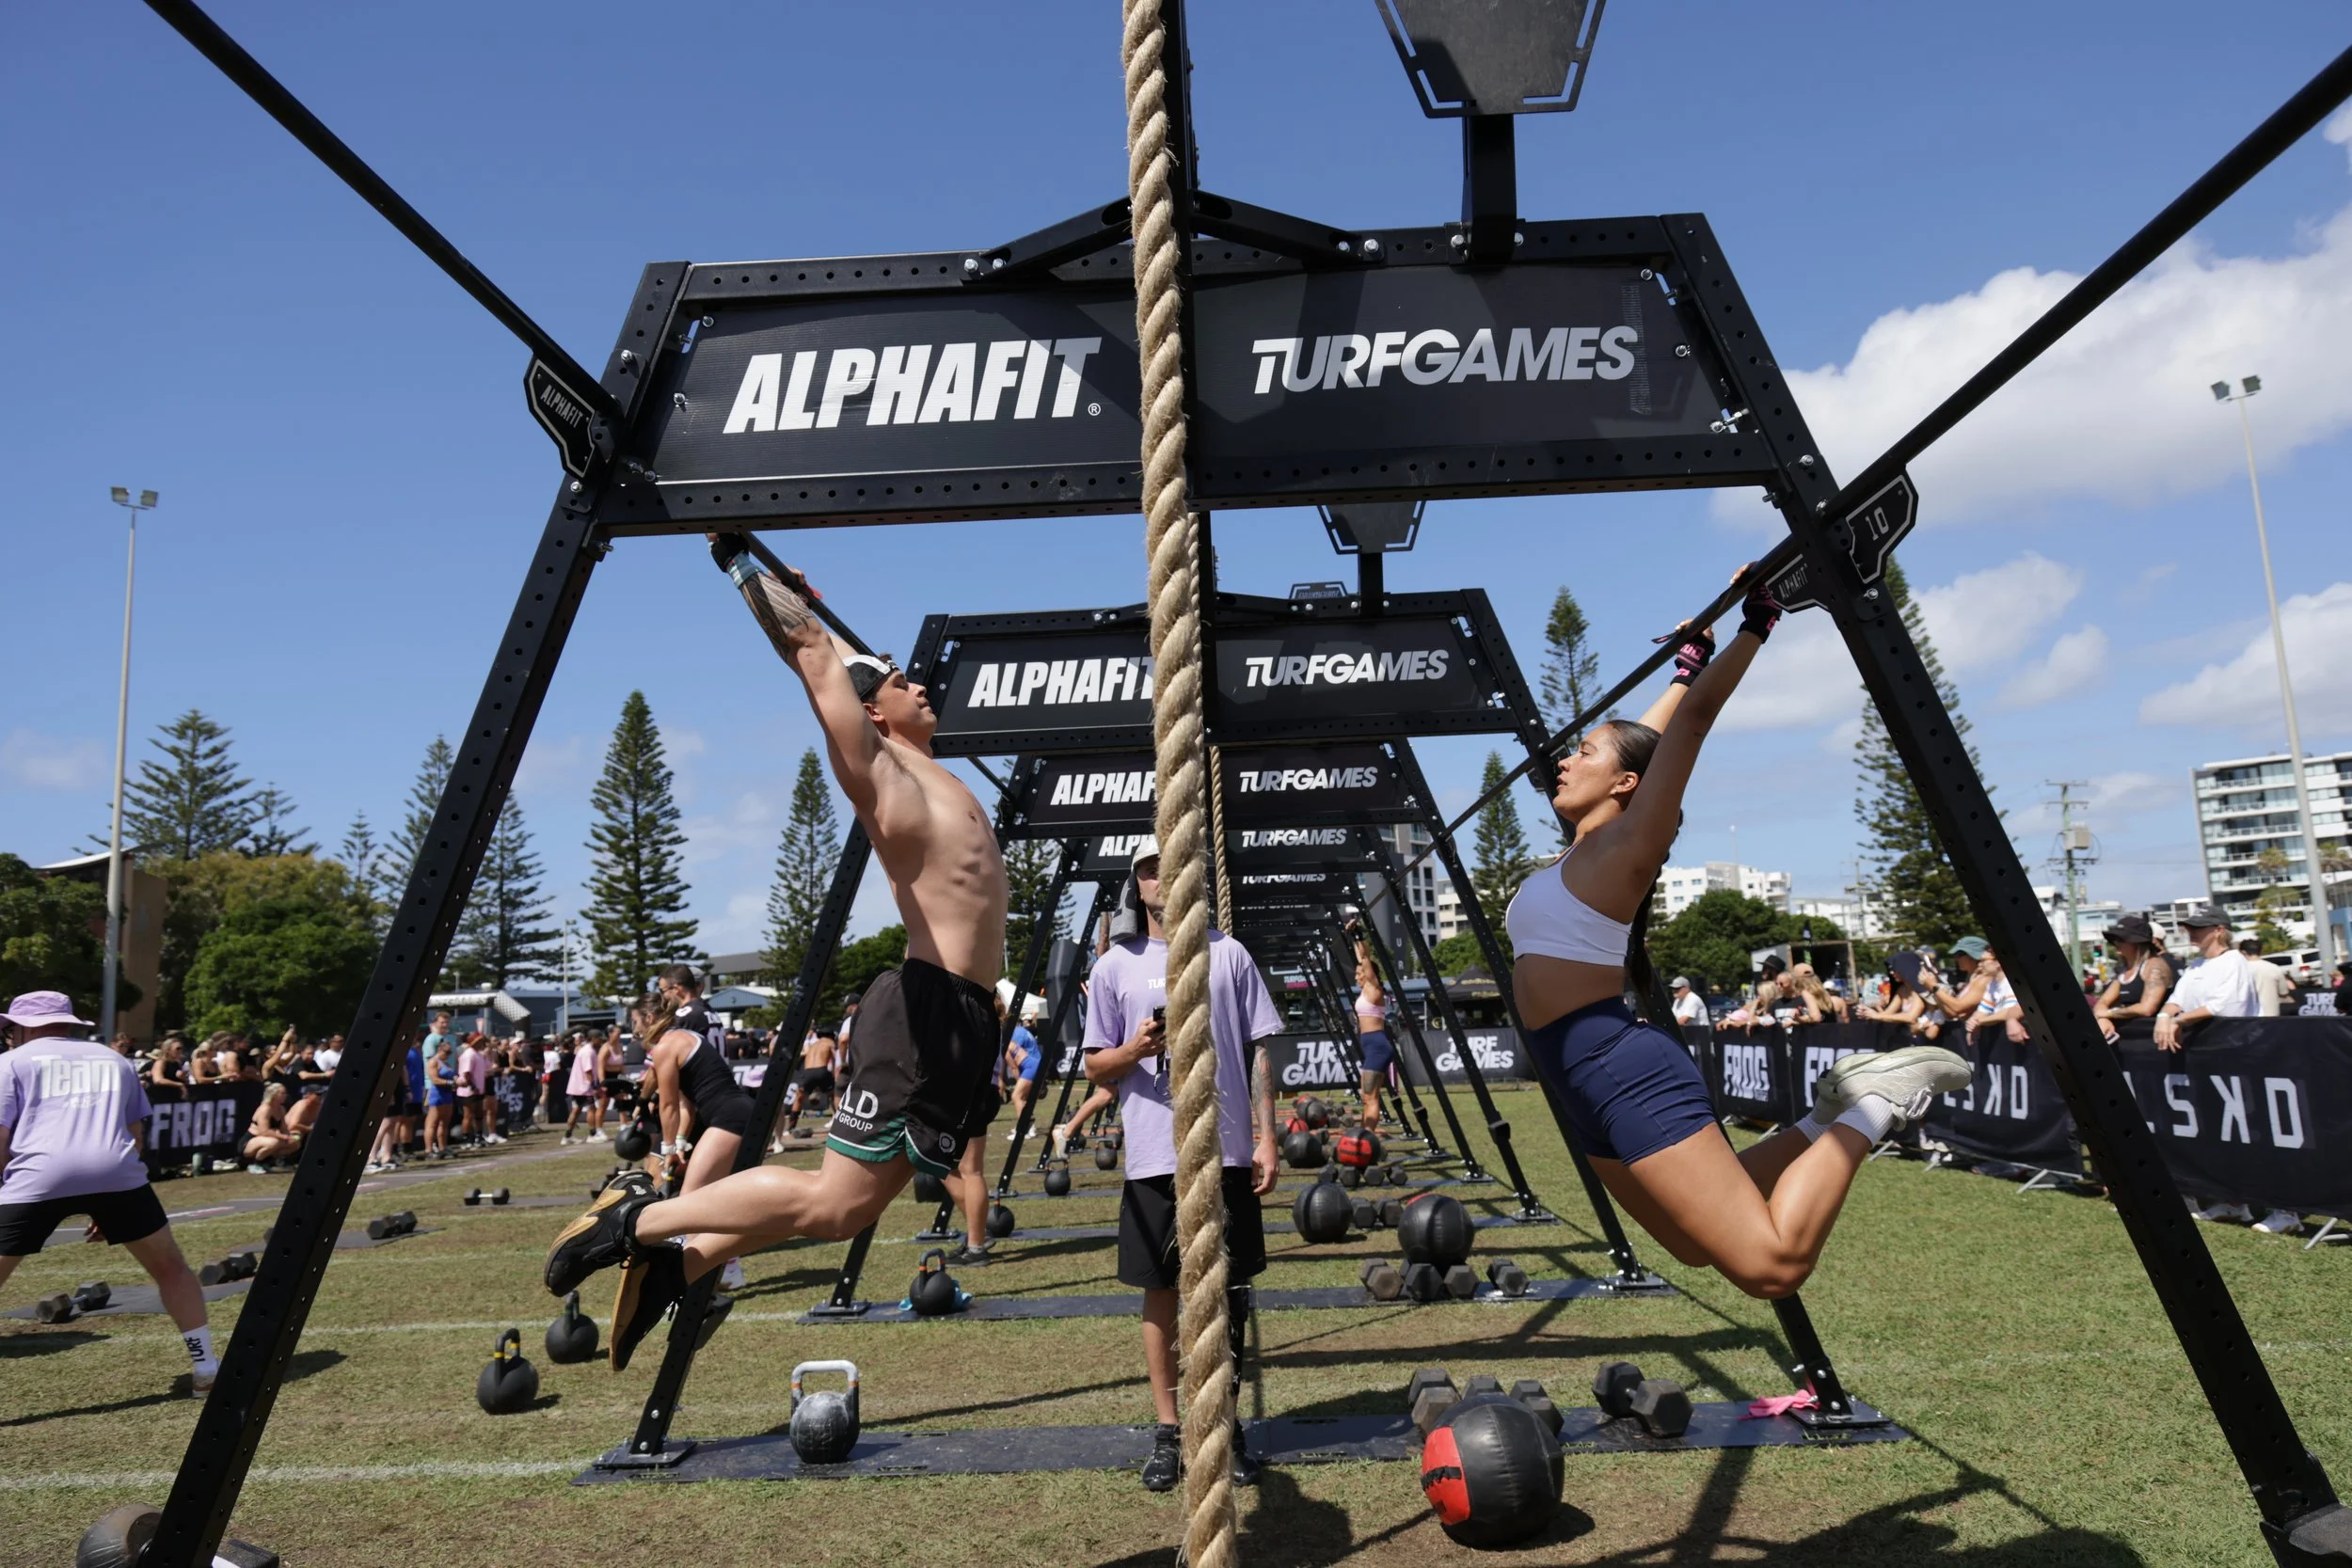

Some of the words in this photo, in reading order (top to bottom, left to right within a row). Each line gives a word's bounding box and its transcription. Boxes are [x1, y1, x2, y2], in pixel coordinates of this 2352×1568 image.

[1252, 325, 1639, 394] TURFGAMES
[540, 384, 583, 429] ALPHAFIT
[1865, 506, 1889, 541] 10
[1246, 649, 1450, 688] TURFGAMES
[1239, 766, 1378, 793] TURFGAMES
[1242, 828, 1347, 847] TURFGAMES
[1724, 1044, 1771, 1101] FROG
[151, 1099, 236, 1150] FROG
[838, 1113, 873, 1132] GROUP
